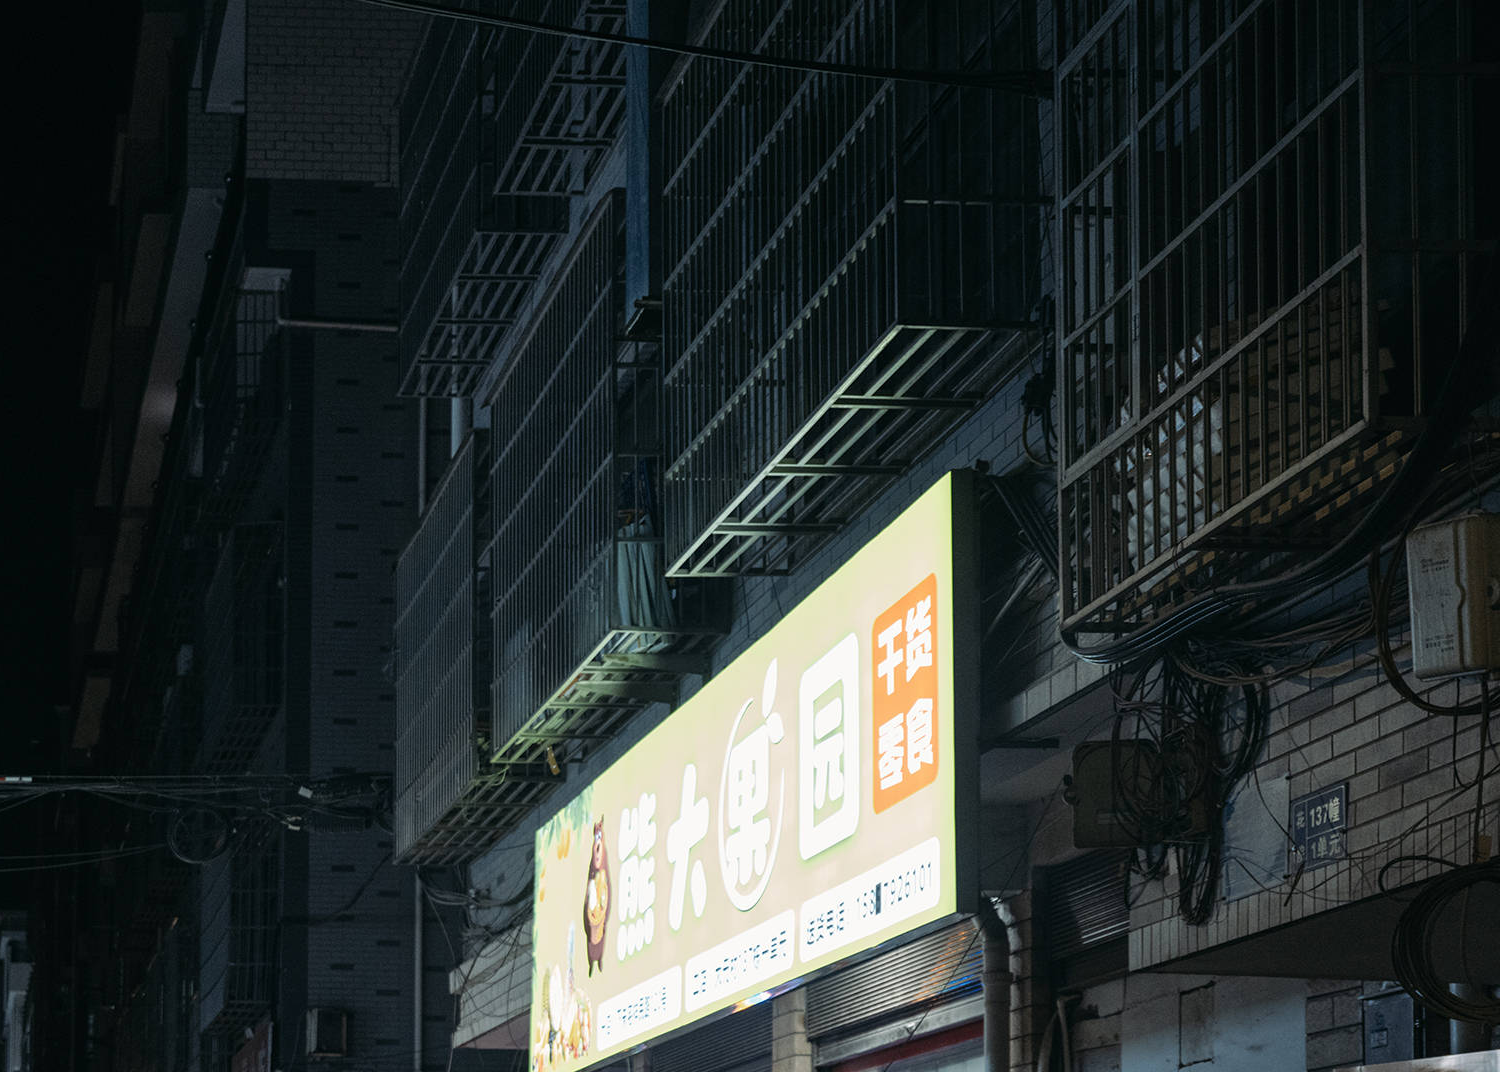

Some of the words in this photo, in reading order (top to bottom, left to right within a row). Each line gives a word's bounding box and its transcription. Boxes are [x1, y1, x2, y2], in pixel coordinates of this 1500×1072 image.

[877, 594, 934, 696] 干货
[877, 697, 935, 791] 零食
[617, 632, 861, 962] 熊大果园
